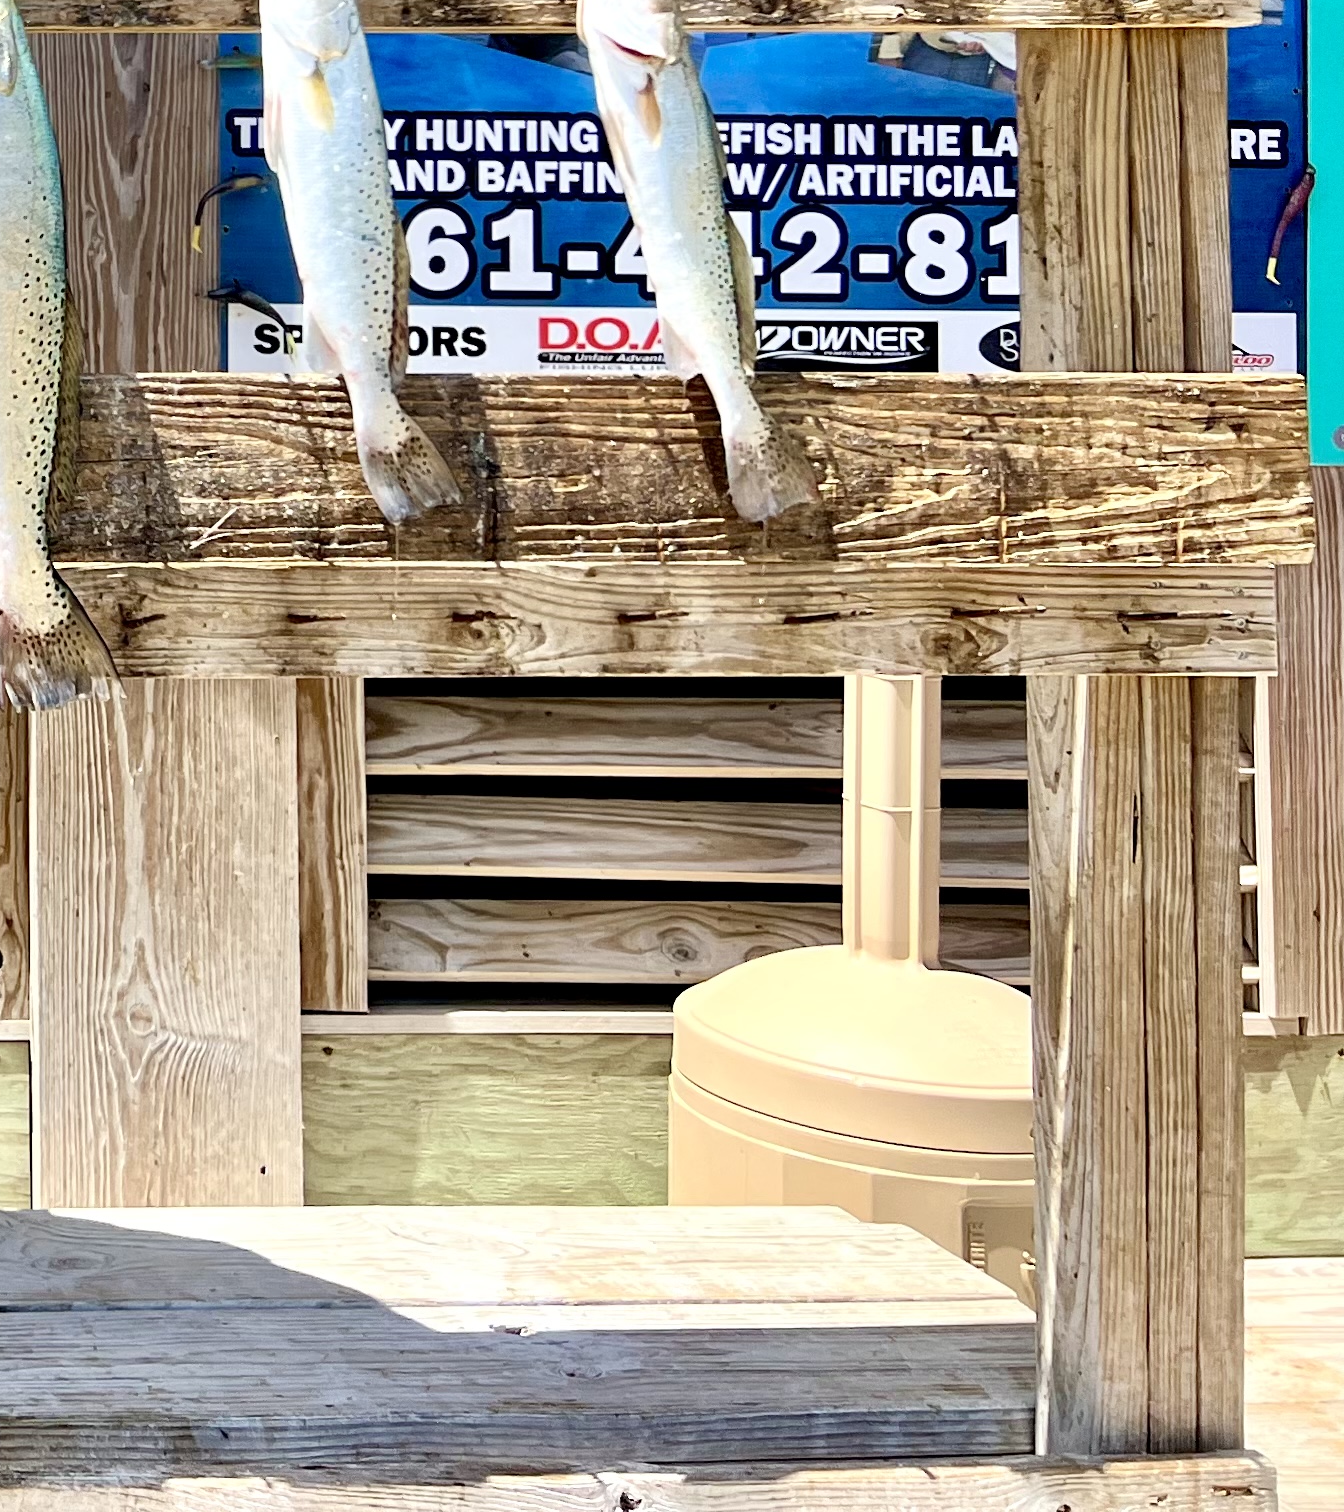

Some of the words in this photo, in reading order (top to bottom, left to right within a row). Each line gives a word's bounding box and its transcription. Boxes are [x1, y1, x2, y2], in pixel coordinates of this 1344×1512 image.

[415, 118, 600, 154] HUNTING
[833, 122, 876, 156] IN
[885, 123, 961, 157] THE
[386, 159, 467, 193] AND
[477, 160, 624, 195] BAFFIN
[726, 162, 789, 203] W/
[797, 163, 1017, 198] ARTIFICIAL
[253, 323, 487, 357] SPORS
[791, 325, 925, 352] OWNER
